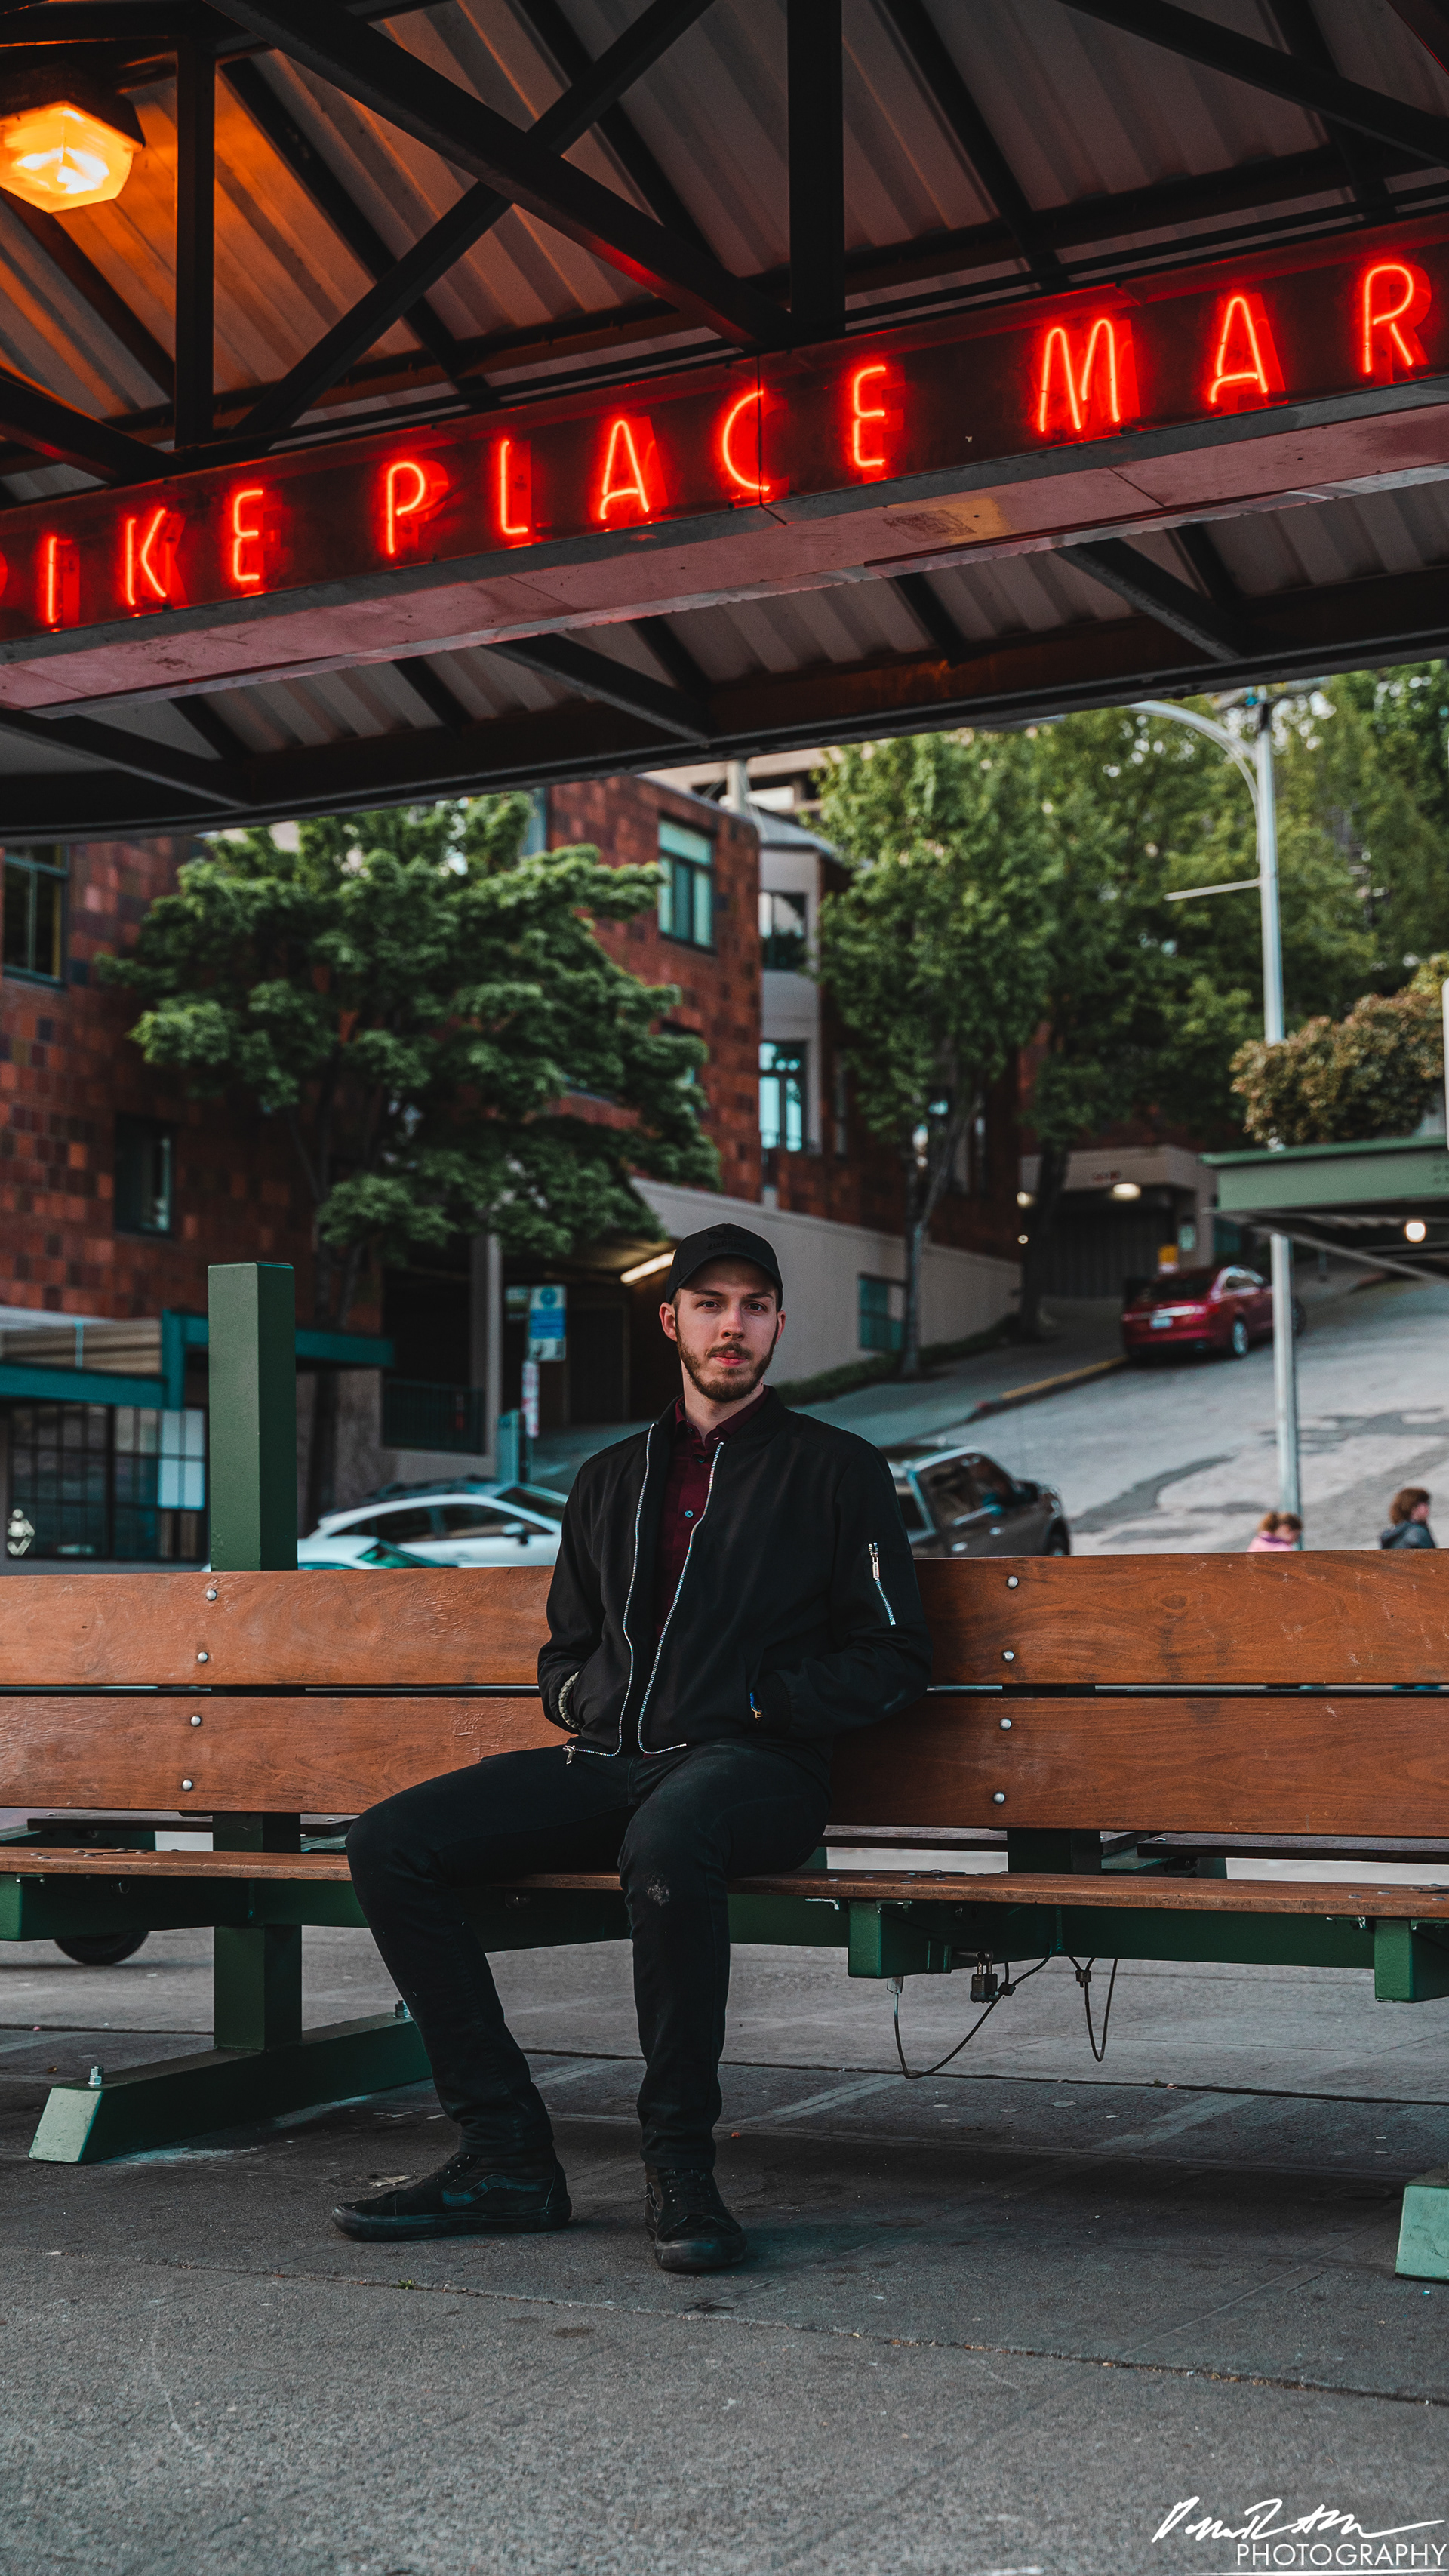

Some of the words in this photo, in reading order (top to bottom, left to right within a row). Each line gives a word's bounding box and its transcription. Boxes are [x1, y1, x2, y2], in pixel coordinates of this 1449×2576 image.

[0, 489, 267, 626] IKE
[386, 364, 888, 556] PLACE
[1037, 263, 1425, 434] MAR
